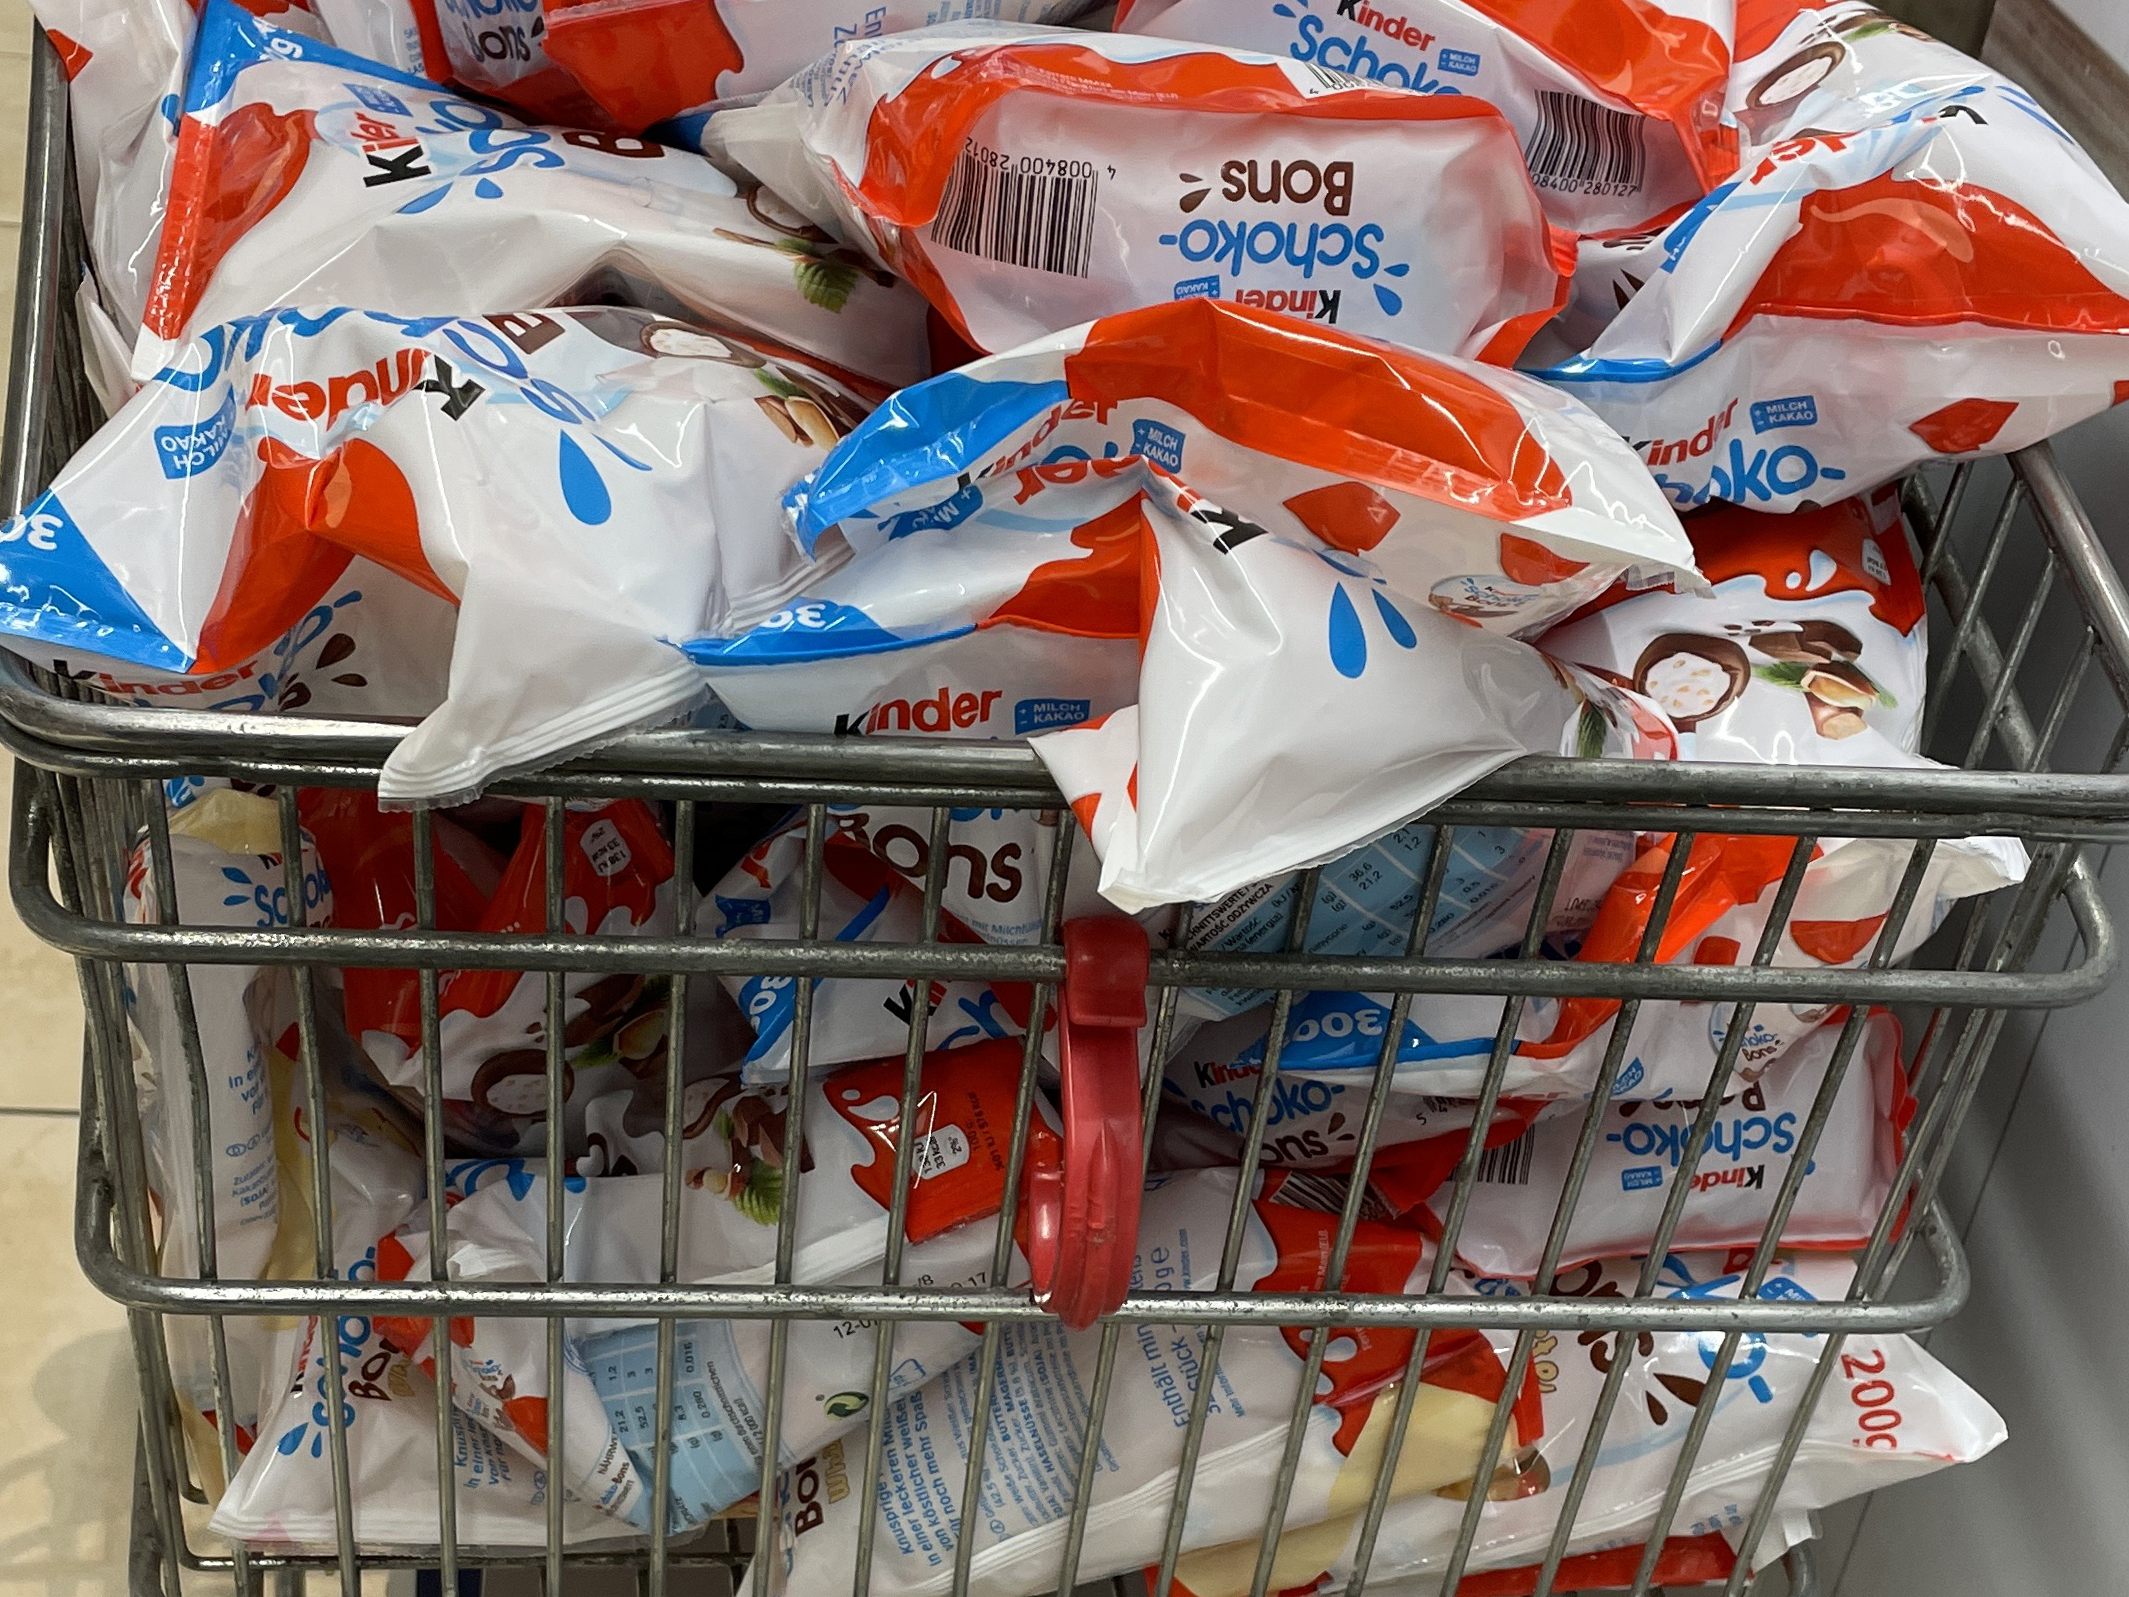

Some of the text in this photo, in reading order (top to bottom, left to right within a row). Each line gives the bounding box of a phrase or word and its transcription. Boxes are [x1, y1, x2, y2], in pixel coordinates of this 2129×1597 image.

[1337, 0, 1435, 51] Kinder
[1020, 156, 1093, 180] 008400
[1221, 160, 1354, 216] Bons
[1583, 181, 1637, 197] 280127
[1159, 219, 1385, 279] Schoko-
[1766, 401, 1808, 414] MILCH
[1769, 411, 1814, 424] KAKAO
[1142, 442, 1180, 468] KAKAO
[1147, 427, 1179, 450] MILCH
[834, 687, 1003, 736] Kinder
[1033, 703, 1082, 714] MILCH
[1033, 711, 1085, 723] KAKAO
[1689, 1164, 1765, 1192] Kinde
[1150, 1362, 1190, 1427] Enthält
[919, 1434, 940, 1475] mehr
[1018, 1397, 1056, 1473] HASELNÜSSE
[887, 1448, 914, 1517] leckeren
[905, 1452, 941, 1528] köstlicher
[931, 1475, 956, 1516] noch
